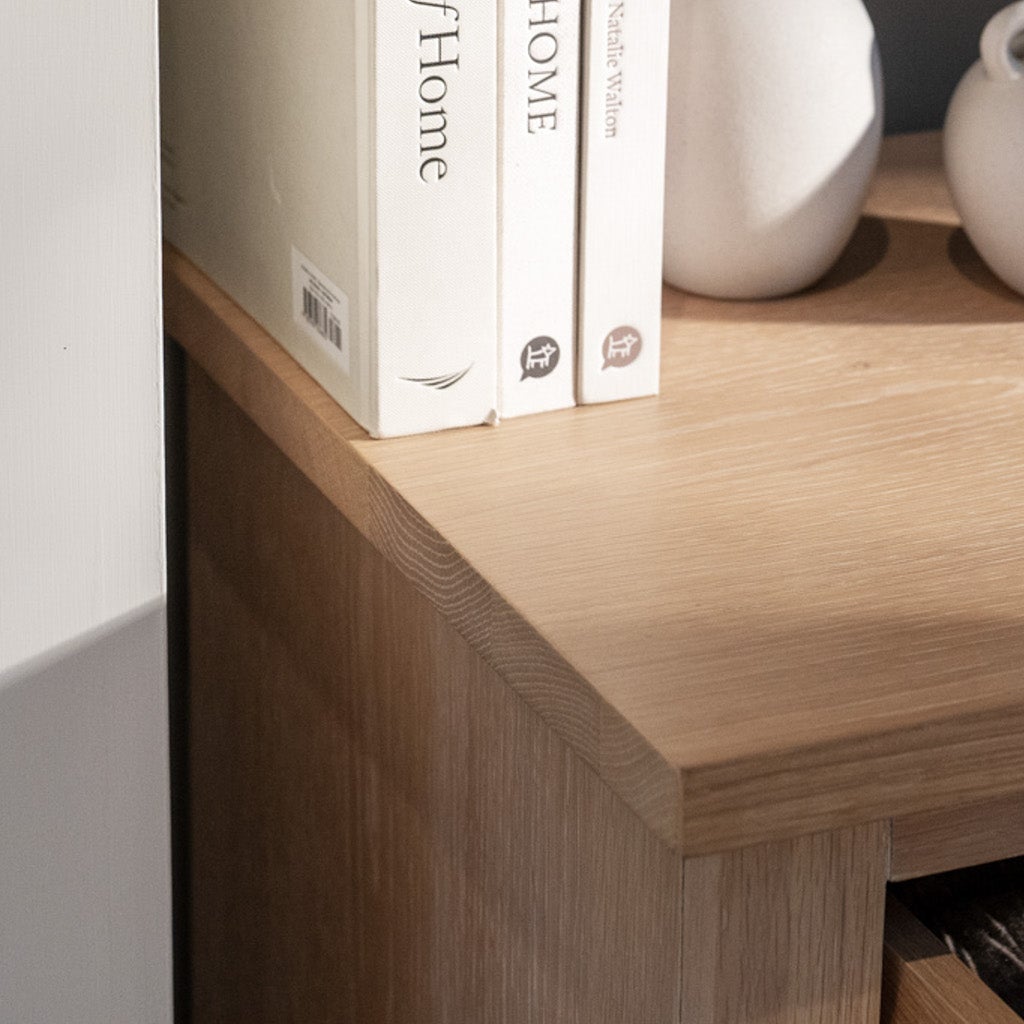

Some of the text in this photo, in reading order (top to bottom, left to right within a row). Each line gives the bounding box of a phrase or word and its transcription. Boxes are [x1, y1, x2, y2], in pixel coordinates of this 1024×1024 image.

[418, 25, 460, 183] Home
[605, 1, 624, 139] Natalie Walton
